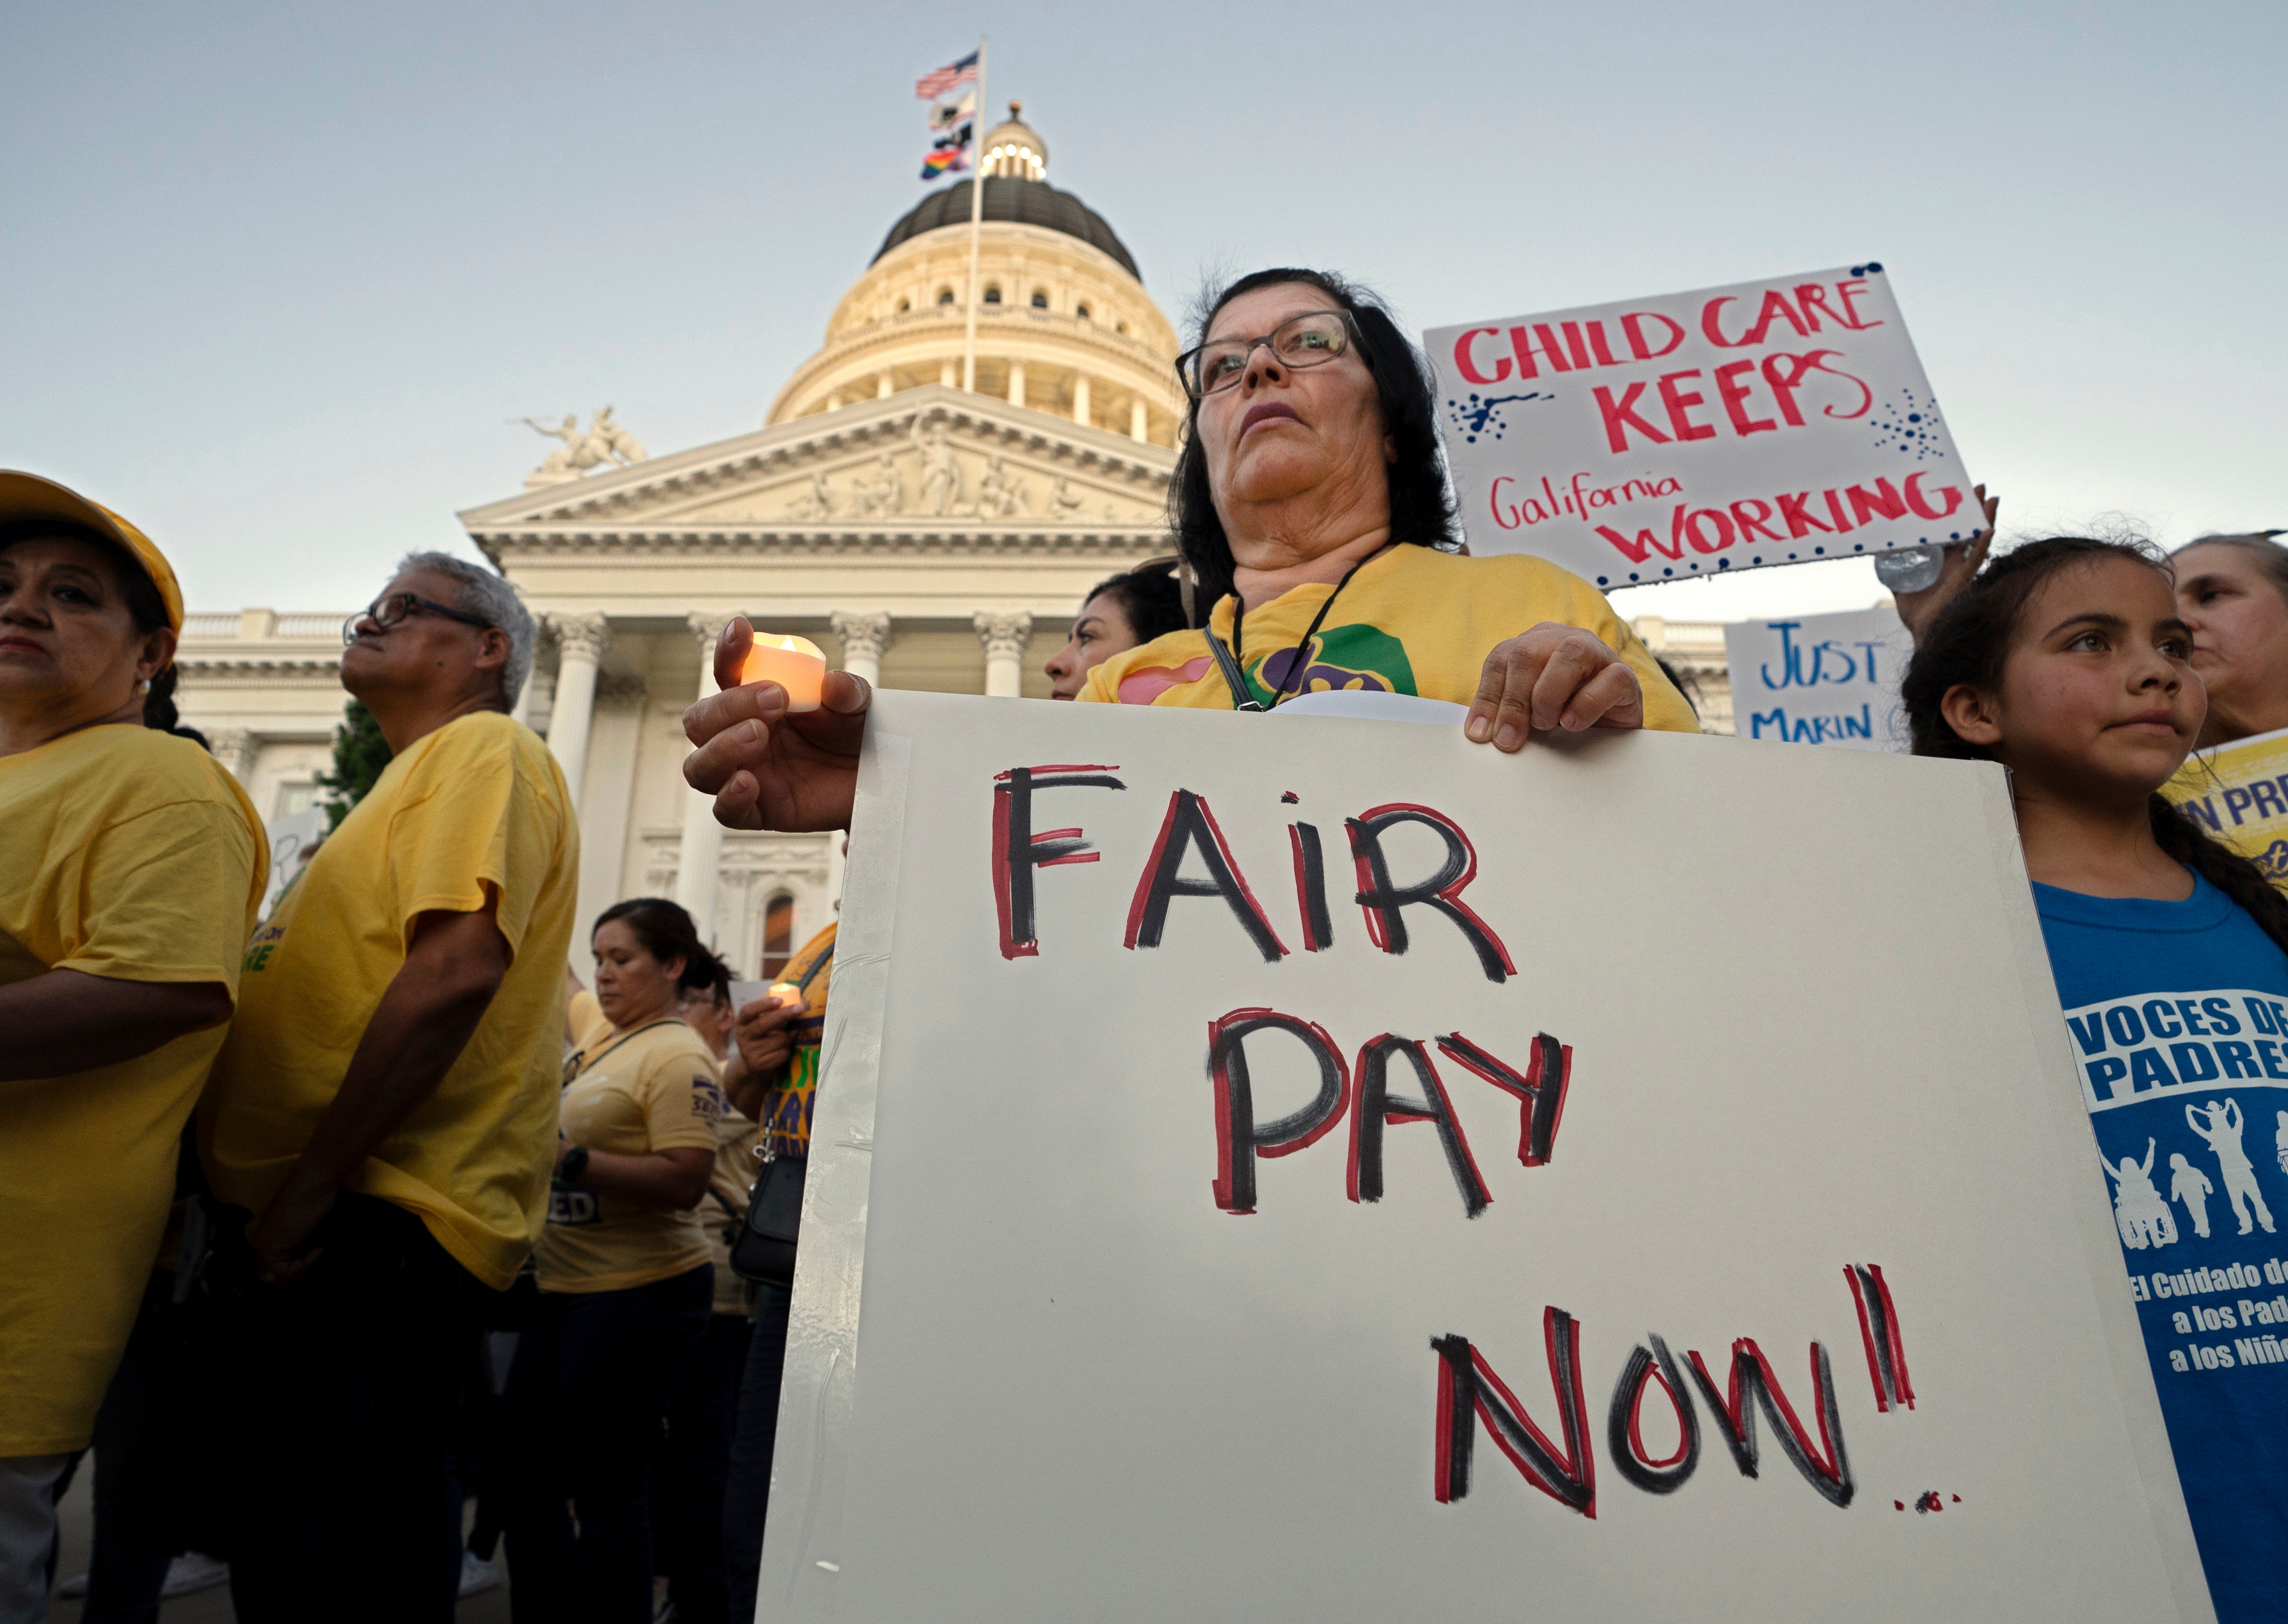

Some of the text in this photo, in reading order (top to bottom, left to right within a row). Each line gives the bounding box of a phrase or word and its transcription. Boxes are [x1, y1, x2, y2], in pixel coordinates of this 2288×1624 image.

[1454, 279, 1884, 385] CHILD CARE
[1593, 349, 1872, 453] KEEPS
[1490, 471, 1682, 531] California
[1595, 471, 1964, 563] WORKING
[1761, 623, 1886, 690] JUST
[2066, 997, 2241, 1056] VOCES
[2085, 1040, 2288, 1102] PADRE
[1205, 1007, 1573, 1220] PAY
[2152, 1262, 2261, 1299] Cuidado
[2172, 1312, 2192, 1334] a
[2191, 1305, 2237, 1332] los
[2169, 1350, 2189, 1372] a
[2189, 1344, 2235, 1370] los
